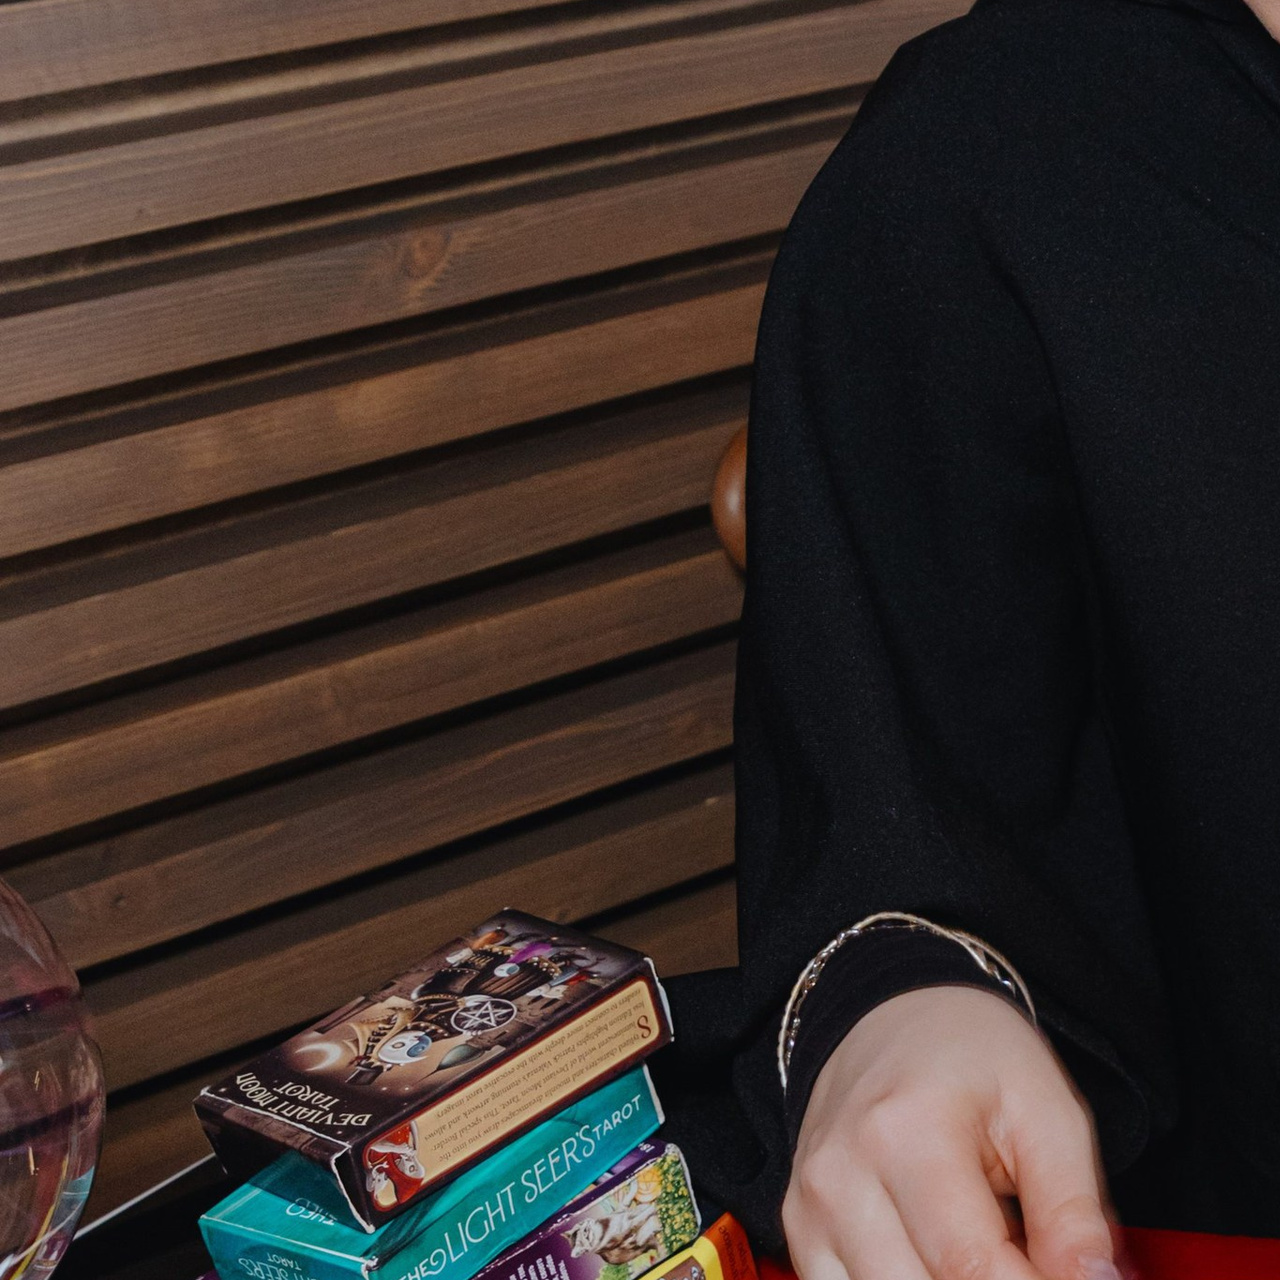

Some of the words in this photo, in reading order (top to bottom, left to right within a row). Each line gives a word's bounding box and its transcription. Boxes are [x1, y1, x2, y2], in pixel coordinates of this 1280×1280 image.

[552, 1044, 576, 1062] Patrick
[541, 1063, 569, 1085] Deviant
[236, 1073, 279, 1107] MOON
[273, 1082, 340, 1111] TAROT
[520, 1080, 542, 1098] Moon
[268, 1101, 372, 1126] DEVIANT
[462, 1097, 491, 1119] artwork
[483, 1107, 499, 1121] This
[447, 1115, 462, 1128] and
[457, 1115, 483, 1137] special
[444, 1182, 515, 1263] LIGHT
[521, 1124, 596, 1203] SEER'S
[592, 1094, 642, 1137] TAROT
[267, 1253, 302, 1271] TAROT
